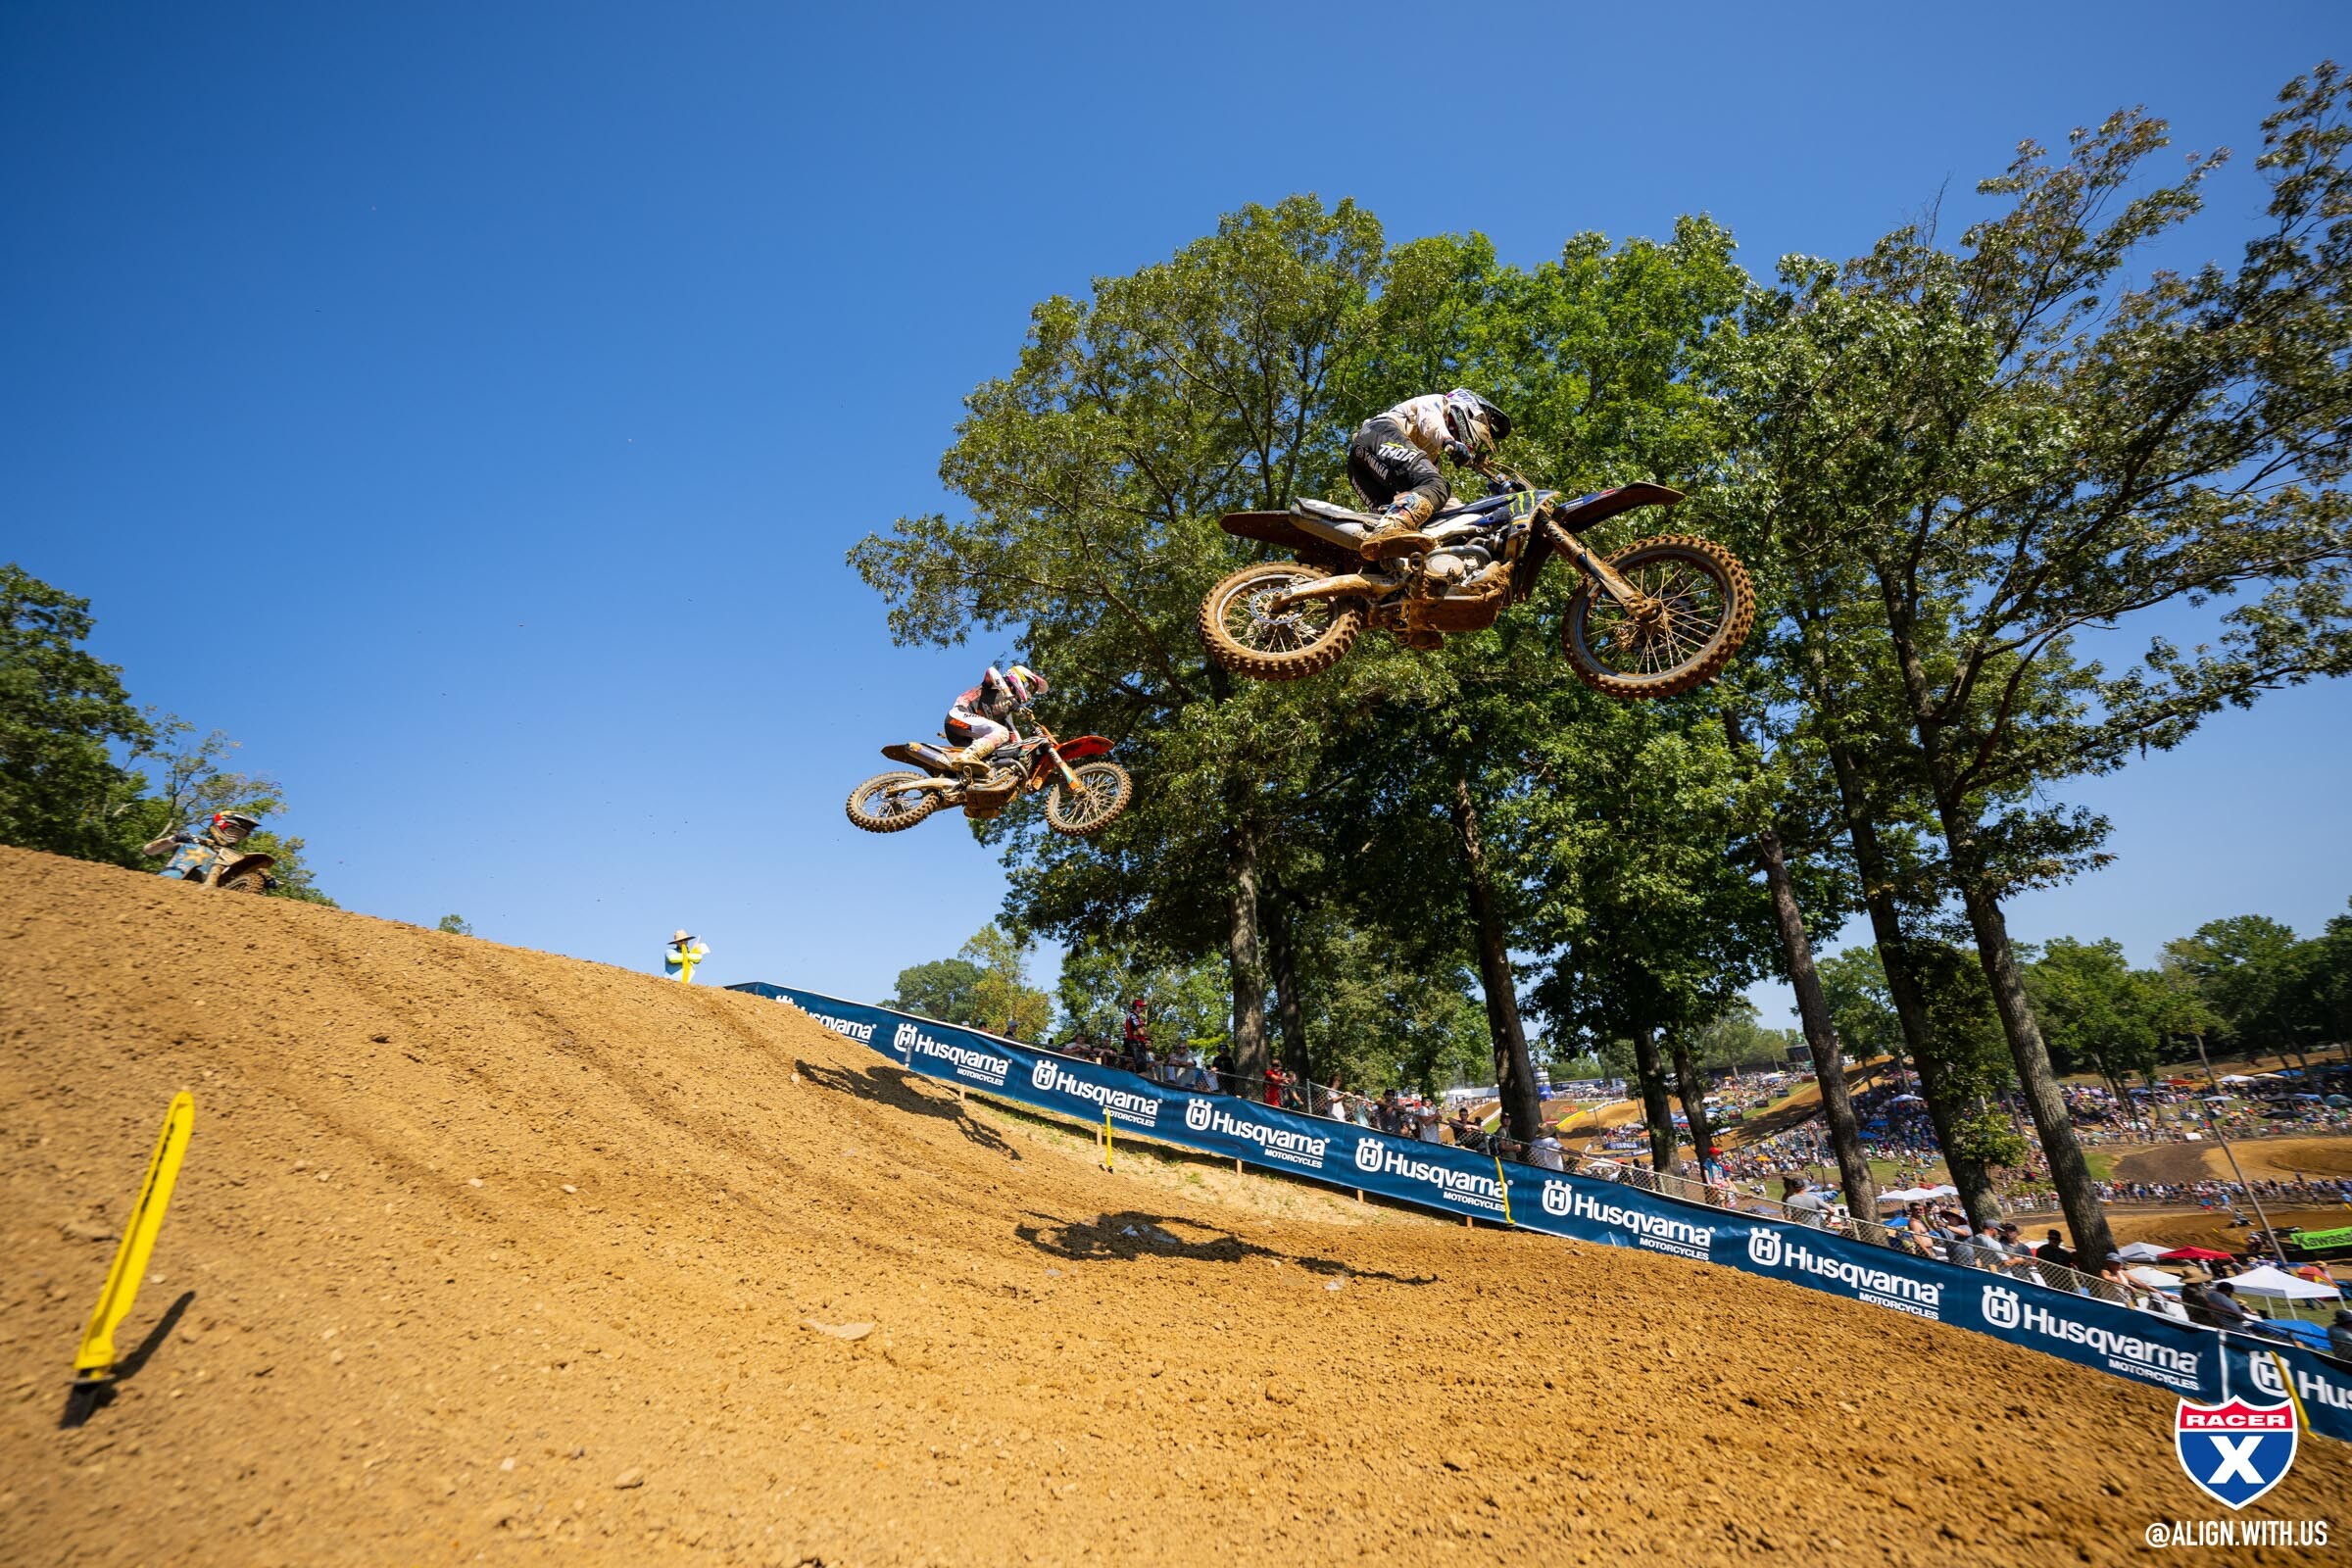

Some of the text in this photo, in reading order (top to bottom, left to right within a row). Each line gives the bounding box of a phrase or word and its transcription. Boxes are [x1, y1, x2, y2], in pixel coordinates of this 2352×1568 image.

[1363, 451, 1389, 480] YAMAHA
[914, 1034, 1009, 1075] Husqvarna
[956, 1067, 1004, 1087] MOTORCYCLES
[1055, 1071, 1158, 1116] Husqvarna
[1211, 1110, 1326, 1156] Husqvarna
[1264, 1149, 1323, 1169] MOTORCYCLES
[1384, 1151, 1509, 1199] Husqvarna
[1443, 1191, 1506, 1212] MOTORCYCLES
[1574, 1194, 1712, 1248] Husqvarna
[1640, 1237, 1710, 1261] MOTORCYCLES
[1785, 1243, 1939, 1306] Husqvarna
[1858, 1292, 1939, 1320] MOTORCYCLES
[2024, 1303, 2198, 1375] Husqvarna
[2108, 1358, 2200, 1392] MOTORCYCLES
